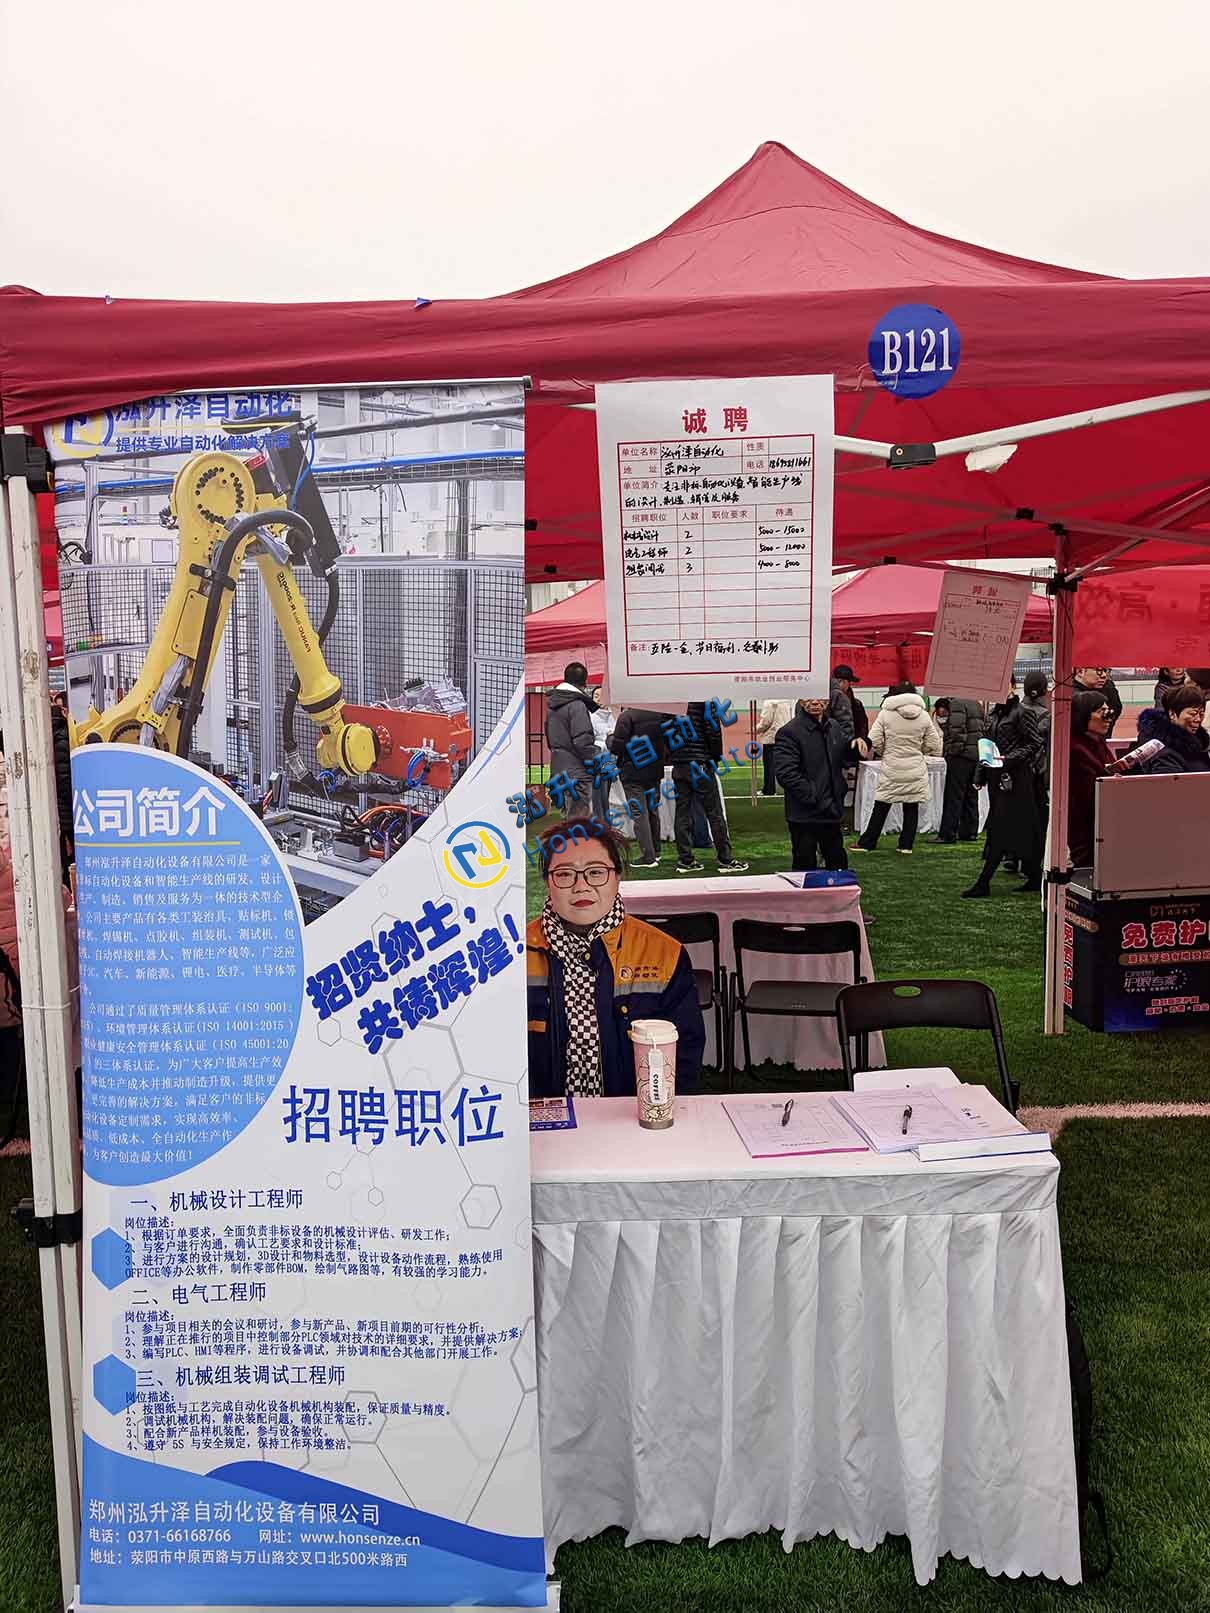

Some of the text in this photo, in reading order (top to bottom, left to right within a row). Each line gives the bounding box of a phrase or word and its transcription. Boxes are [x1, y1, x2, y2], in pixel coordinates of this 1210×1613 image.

[881, 327, 953, 375] B121
[683, 406, 749, 434] 诚聘
[116, 434, 290, 452] 提供专业自动化解决方案
[622, 446, 658, 457] 单位名称
[747, 459, 765, 470] 电话
[623, 481, 658, 491] 单位简介
[631, 513, 667, 523] 招聘职位
[682, 510, 699, 520] 人数
[711, 509, 747, 520] 职位要求
[684, 530, 693, 539] 2
[685, 546, 694, 555] 2
[686, 563, 694, 573] 3
[74, 787, 226, 837] 公司简介
[1121, 919, 1210, 949] 免费护
[283, 1085, 504, 1147] 招聘职位
[89, 1498, 381, 1525] 郑州泓升泽自动化设备有限公司
